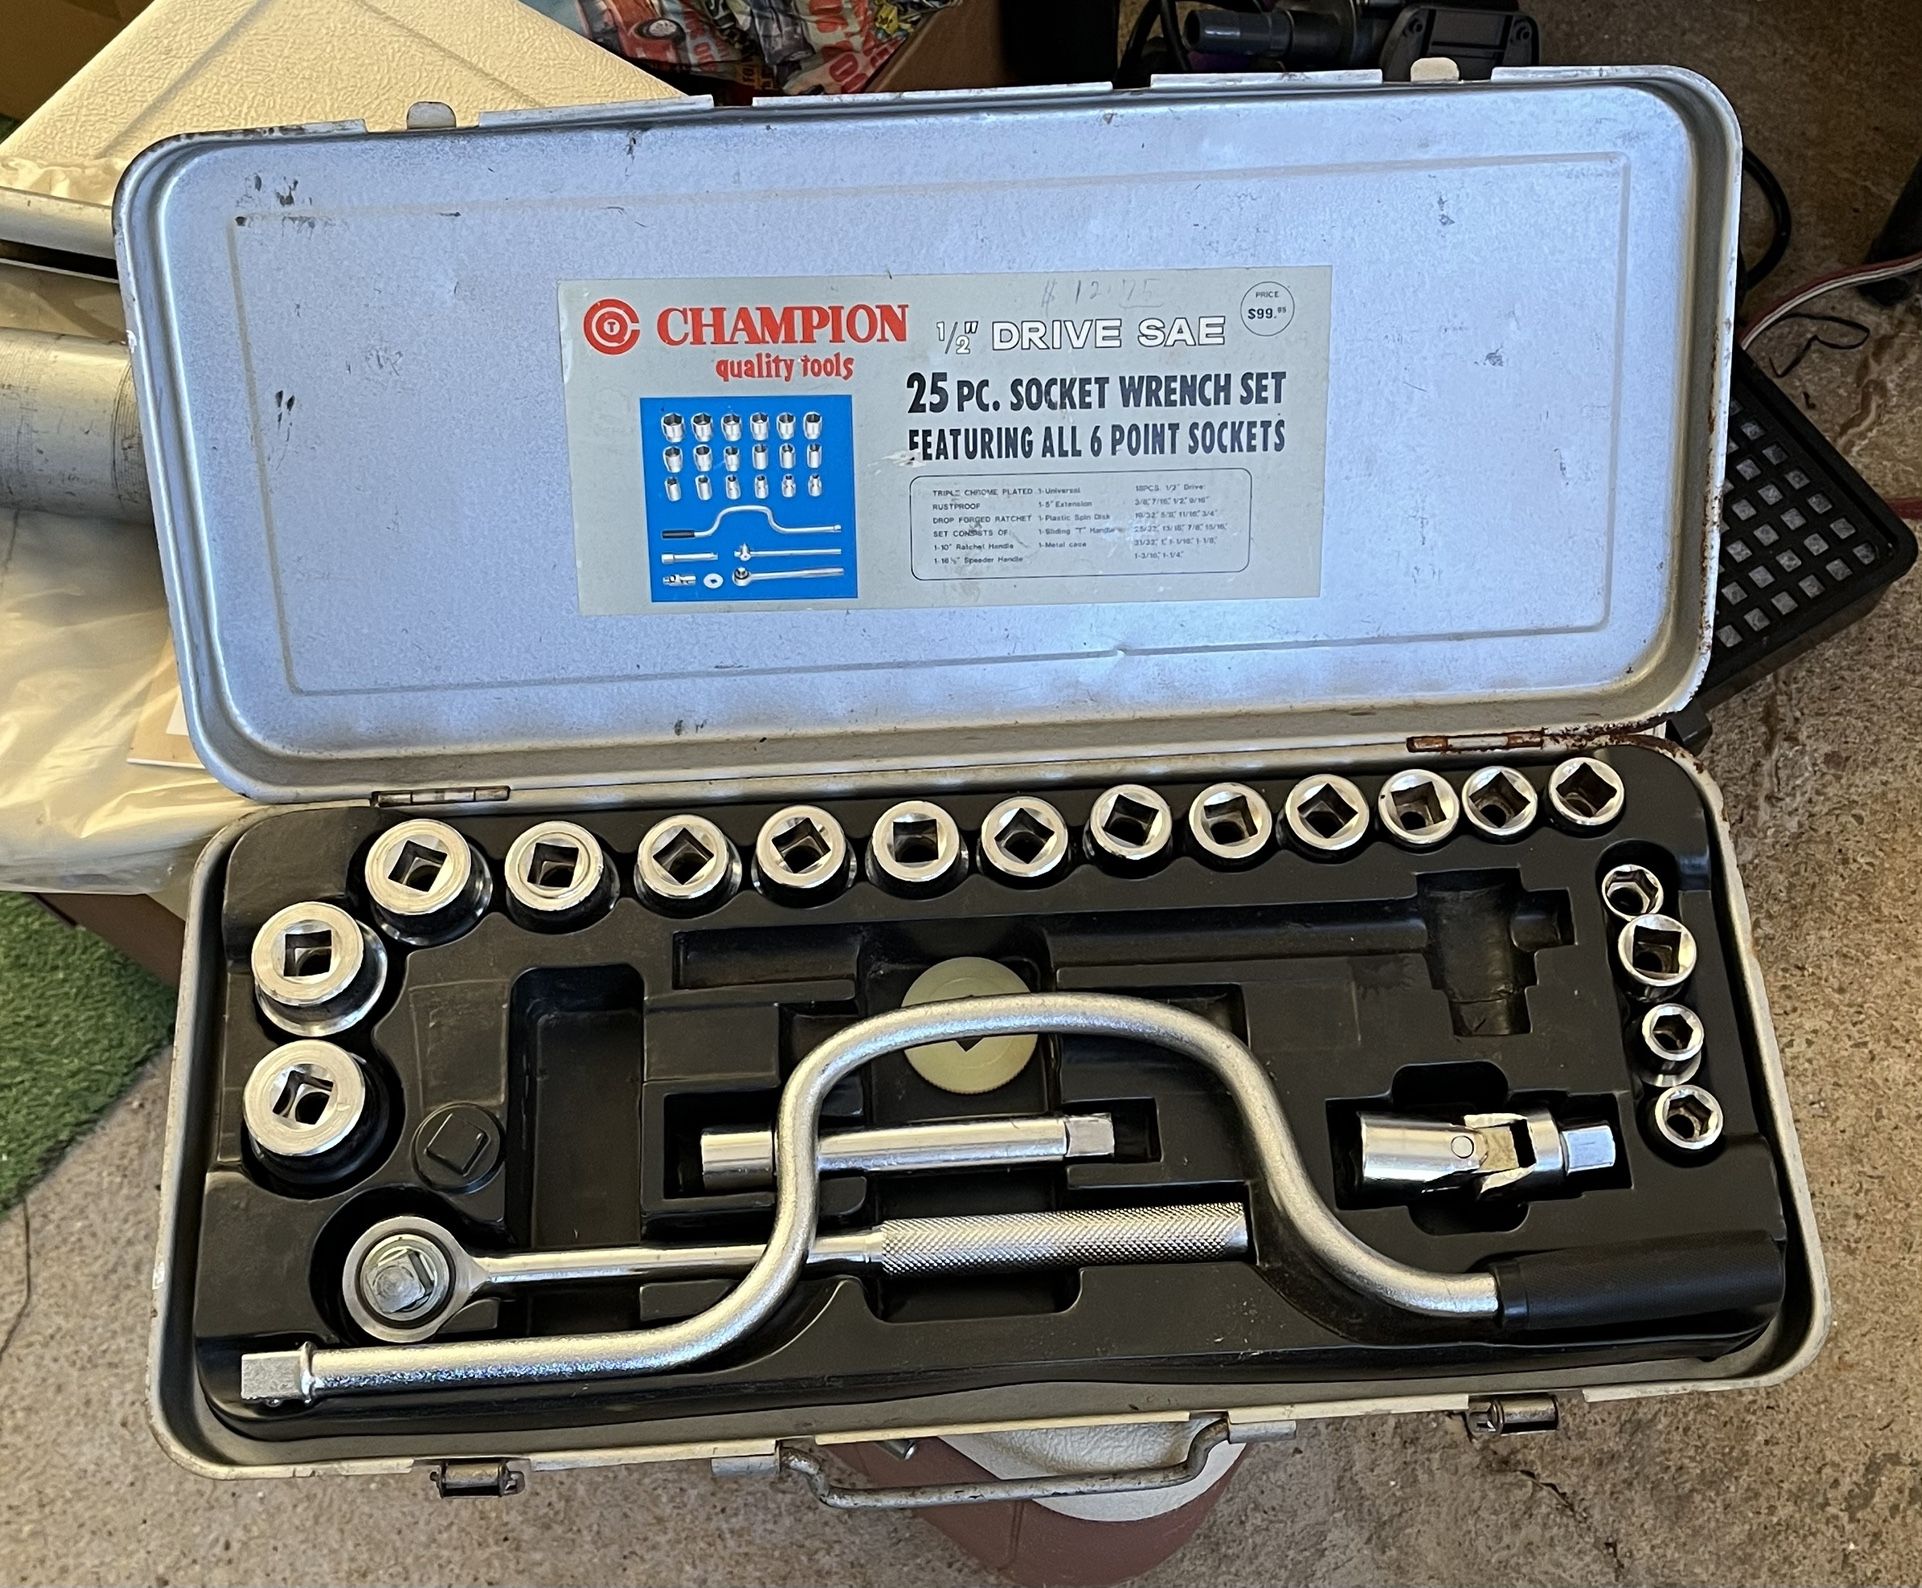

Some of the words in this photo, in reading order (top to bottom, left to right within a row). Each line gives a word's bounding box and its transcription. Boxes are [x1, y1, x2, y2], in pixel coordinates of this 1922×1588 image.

[1255, 290, 1280, 299] PRICE
[657, 303, 909, 346] CHAMPION
[992, 318, 1122, 351] DRIVE
[1138, 315, 1226, 348] SAE
[715, 353, 795, 382] quality
[801, 352, 855, 381] tools
[906, 371, 949, 414] 25
[958, 378, 1001, 412] PC.
[1010, 375, 1110, 411] SOCKET
[1119, 372, 1232, 408] WRENCH
[1240, 370, 1288, 405] SET
[908, 426, 1034, 462] FEATURING
[1041, 424, 1082, 458] ALL
[1090, 424, 1103, 457] 6
[1111, 422, 1180, 456] POINT
[1188, 419, 1286, 454] SOCKETS
[932, 489, 960, 497] TRIPLE
[964, 488, 998, 496] CHROME
[1002, 487, 1033, 496] PLATED
[932, 502, 981, 511] RUSTPROOF
[1055, 500, 1093, 508] Extension
[932, 516, 955, 525] DROP
[958, 515, 991, 524] FORGED
[994, 514, 1033, 523] RATCHET
[1074, 513, 1092, 522] Spin
[1093, 513, 1110, 521] Disk
[933, 530, 948, 538] SET
[953, 529, 994, 538] CONSISTS
[955, 543, 986, 551] Ratchet
[988, 542, 1014, 550] Handle
[964, 556, 995, 565] Speeder
[997, 555, 1024, 563] Handle
